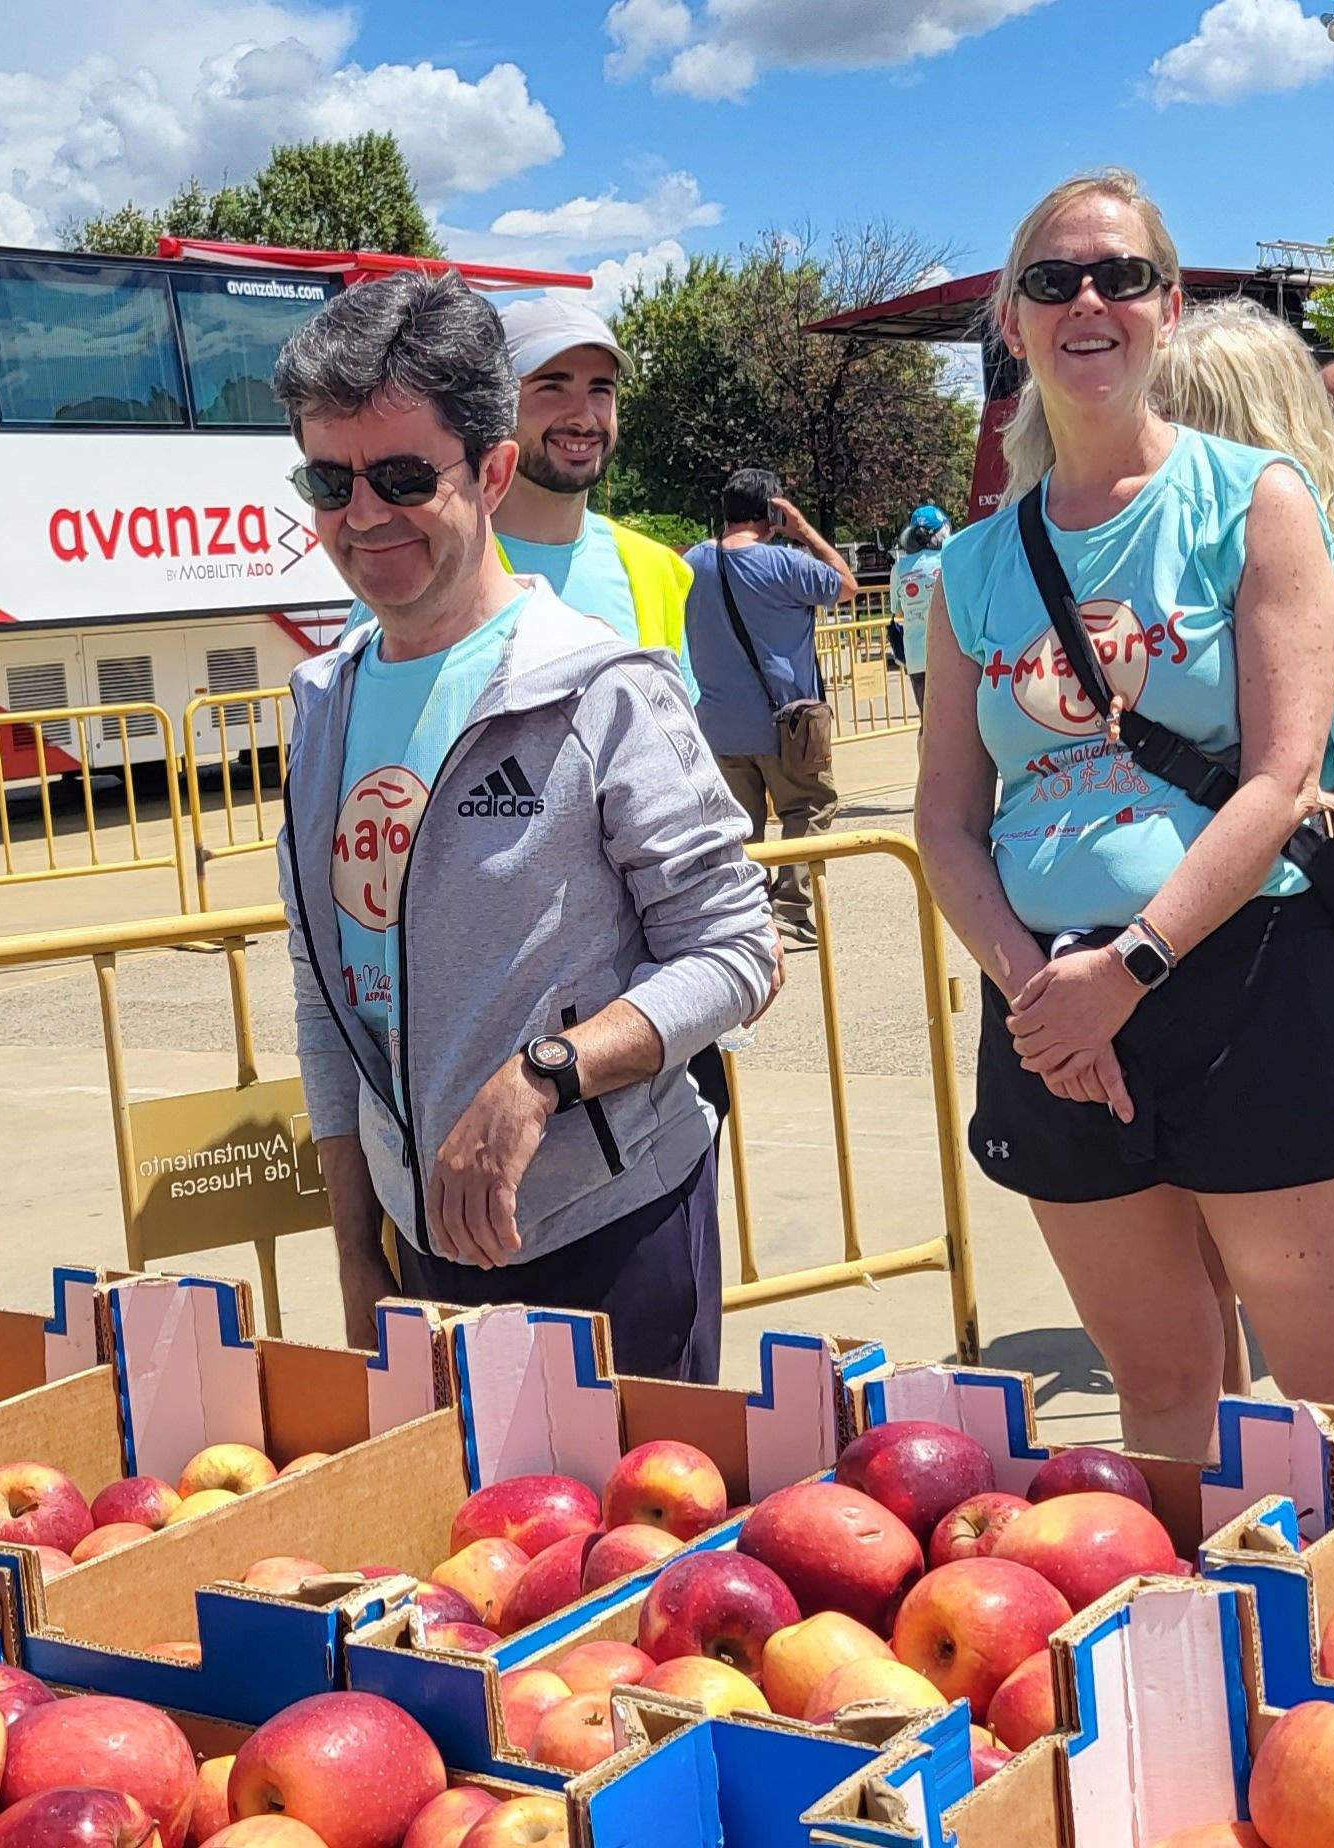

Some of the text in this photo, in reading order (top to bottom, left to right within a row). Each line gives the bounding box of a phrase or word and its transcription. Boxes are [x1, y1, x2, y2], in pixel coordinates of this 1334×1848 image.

[226, 280, 325, 300] avanzabus.com
[49, 504, 272, 563] avanza
[167, 562, 274, 582] BY MOBILITY ADO
[985, 611, 1188, 700] +maores
[457, 795, 545, 818] adidas
